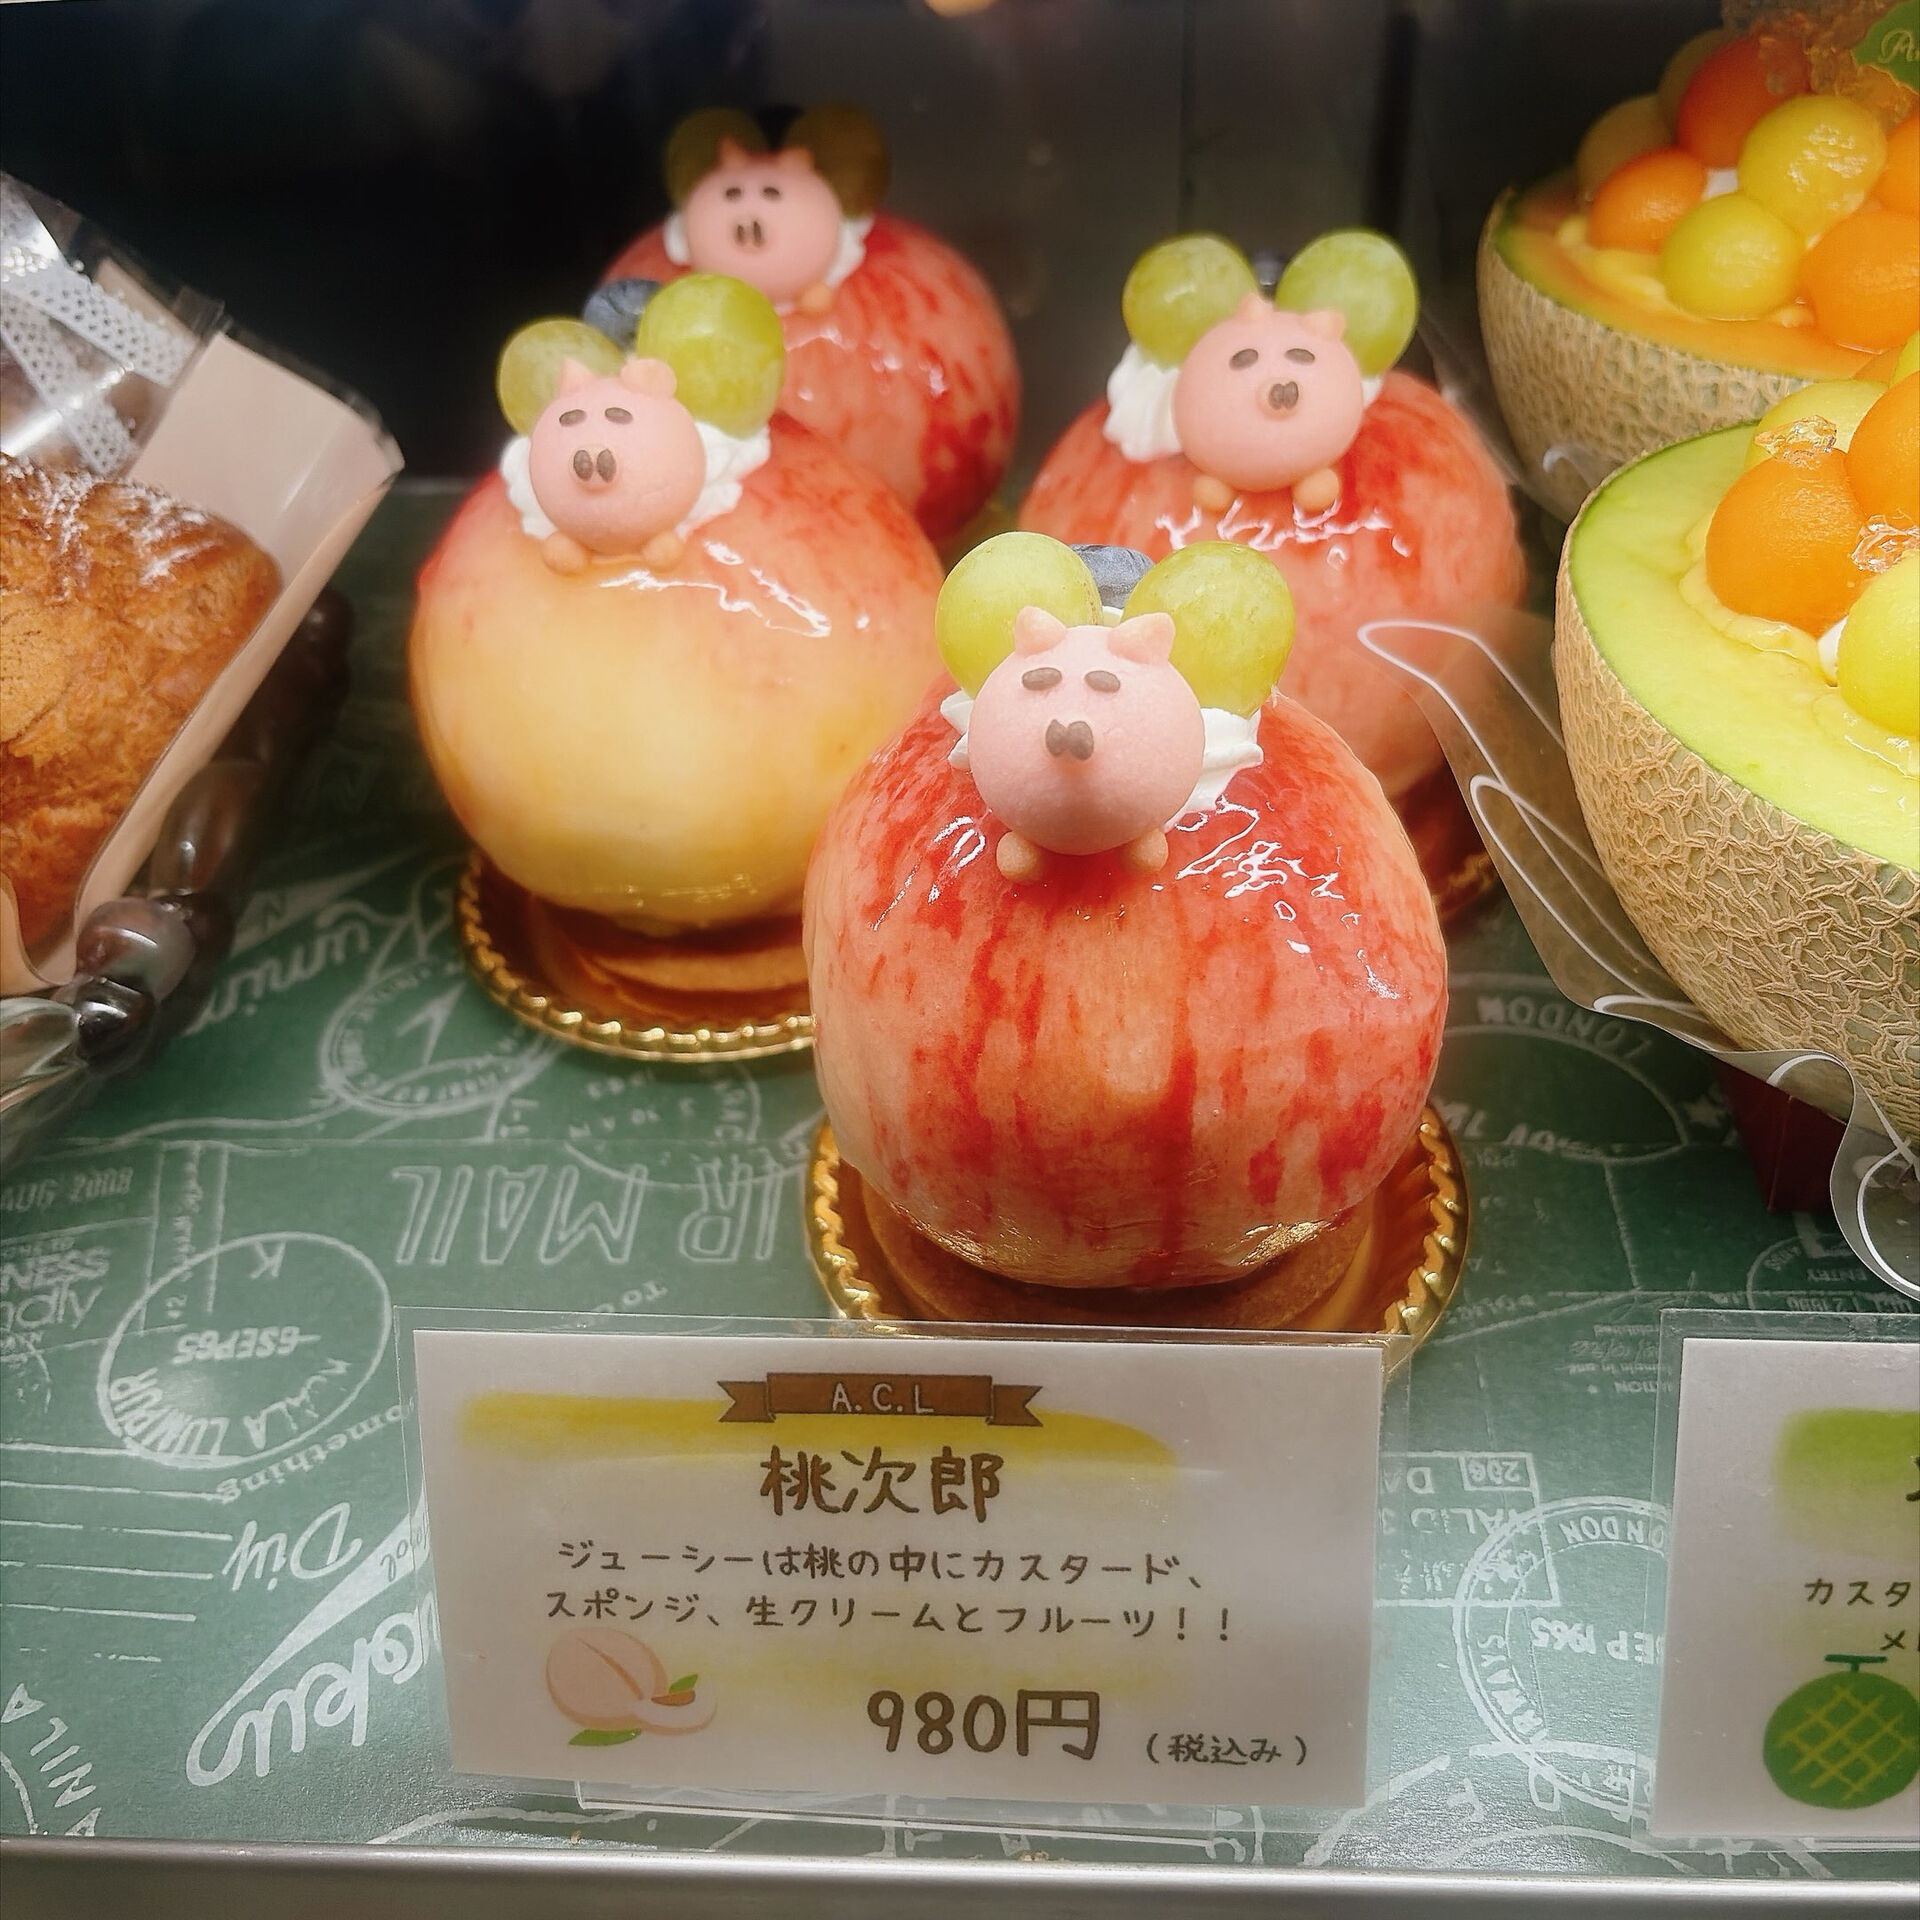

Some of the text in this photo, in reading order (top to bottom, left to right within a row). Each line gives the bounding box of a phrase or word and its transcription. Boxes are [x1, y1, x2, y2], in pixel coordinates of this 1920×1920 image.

[391, 1163, 810, 1266] IR MAIL
[831, 1382, 935, 1416] A.C.L
[215, 1402, 414, 1504] omething
[758, 1446, 1003, 1523] 桃次郎
[222, 1500, 363, 1592] Diy
[557, 1538, 1204, 1590] ジューシーは桃の中にカスタード、
[1558, 1516, 1666, 1551] ONDON
[1804, 1578, 1911, 1608] カスタ
[1880, 1629, 1920, 1651] メ
[866, 1688, 1101, 1762] 980円
